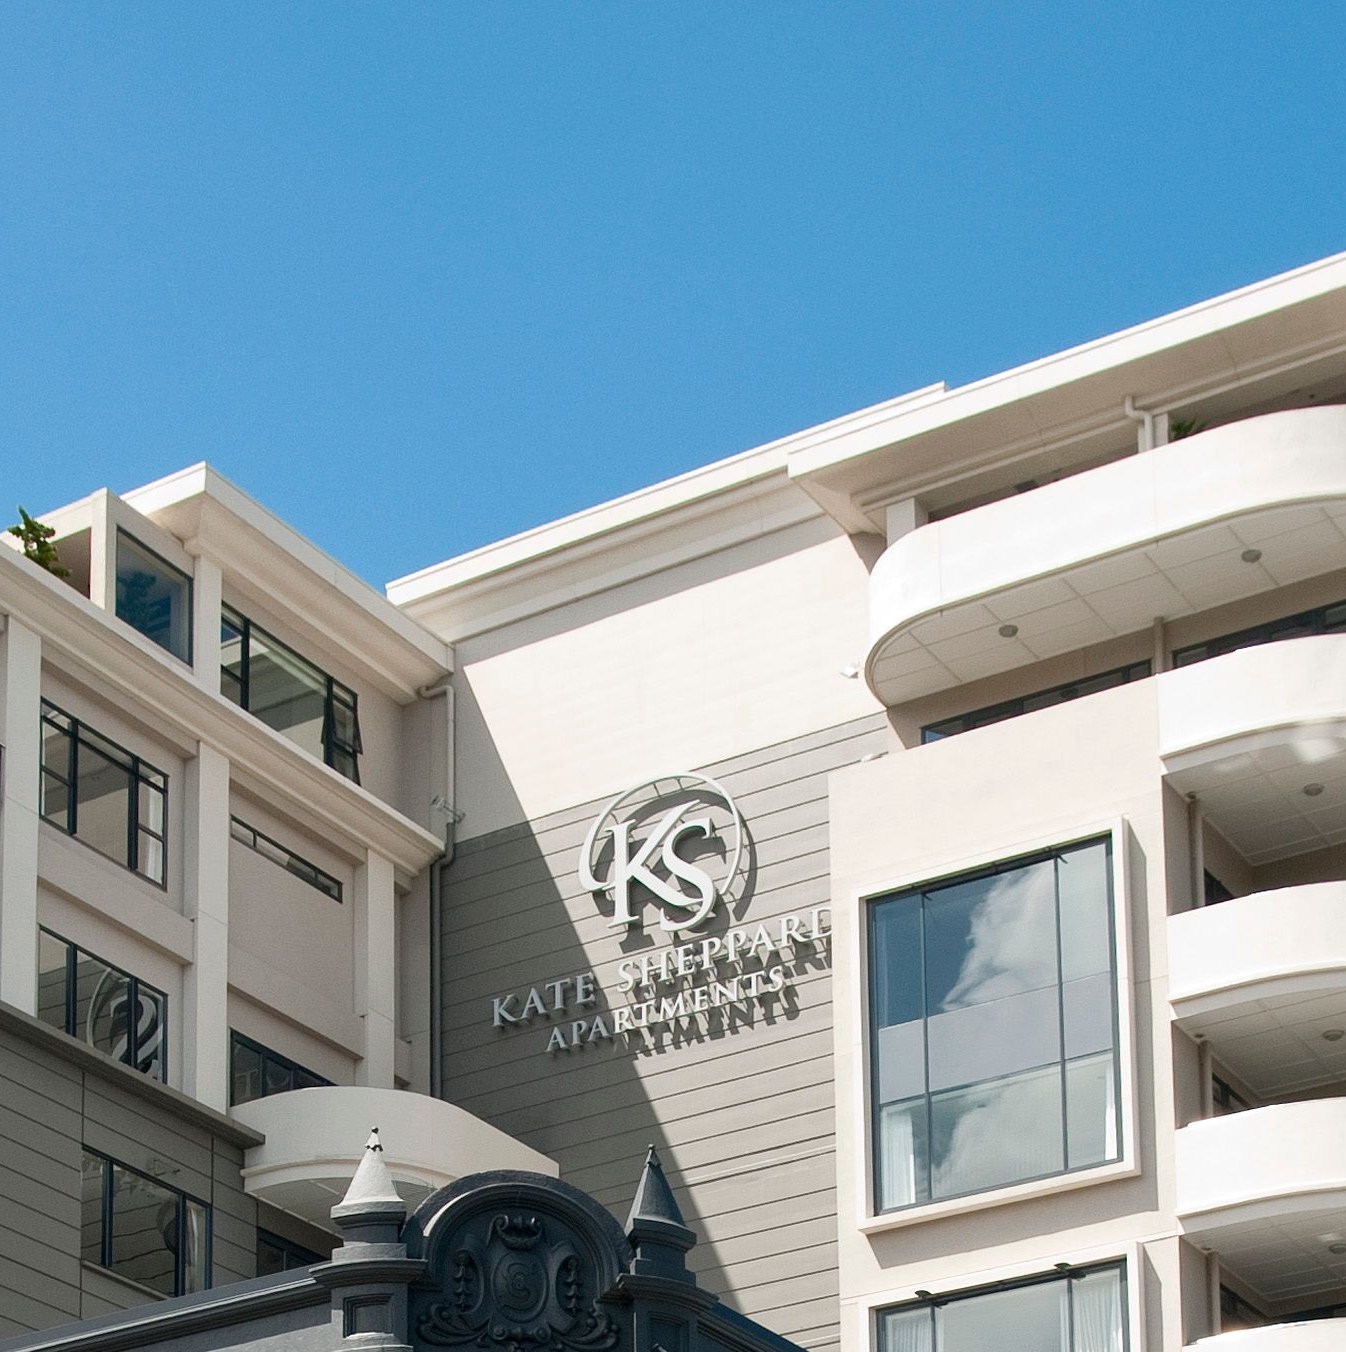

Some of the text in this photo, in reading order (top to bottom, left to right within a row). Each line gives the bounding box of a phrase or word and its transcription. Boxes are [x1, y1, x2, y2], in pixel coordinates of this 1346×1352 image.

[601, 798, 716, 933] KS
[491, 906, 832, 1028] KATE SHEPPARD
[546, 965, 785, 1053] APARTMENTS
